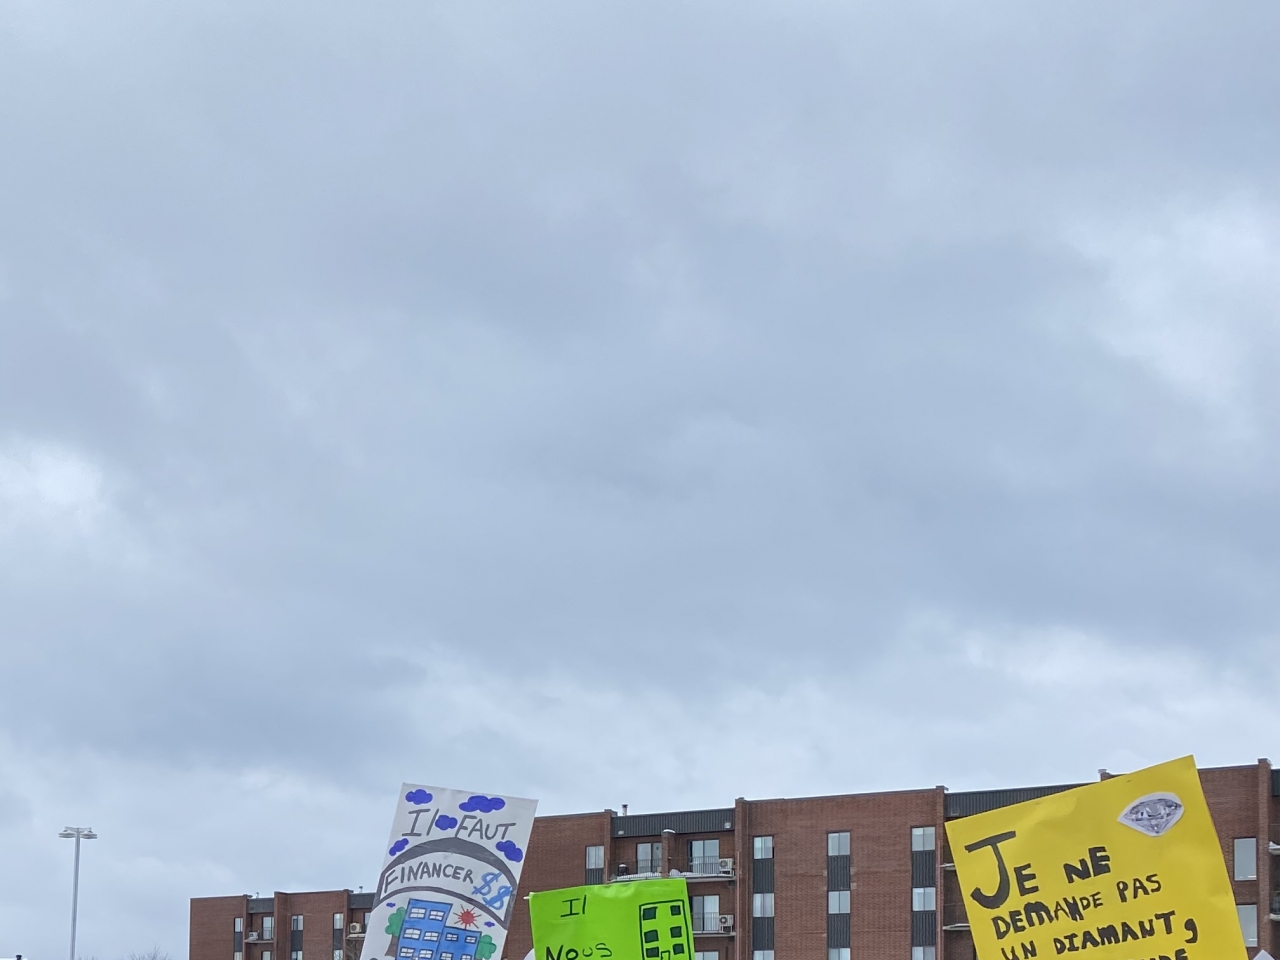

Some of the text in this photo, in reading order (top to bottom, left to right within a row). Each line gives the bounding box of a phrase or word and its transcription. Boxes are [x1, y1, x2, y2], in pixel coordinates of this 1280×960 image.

[402, 808, 516, 840] Il FAUT
[384, 861, 474, 893] FINANCER
[965, 830, 1111, 909] JE NE
[560, 894, 587, 917] Il
[991, 874, 1162, 940] DEMANDE PAS
